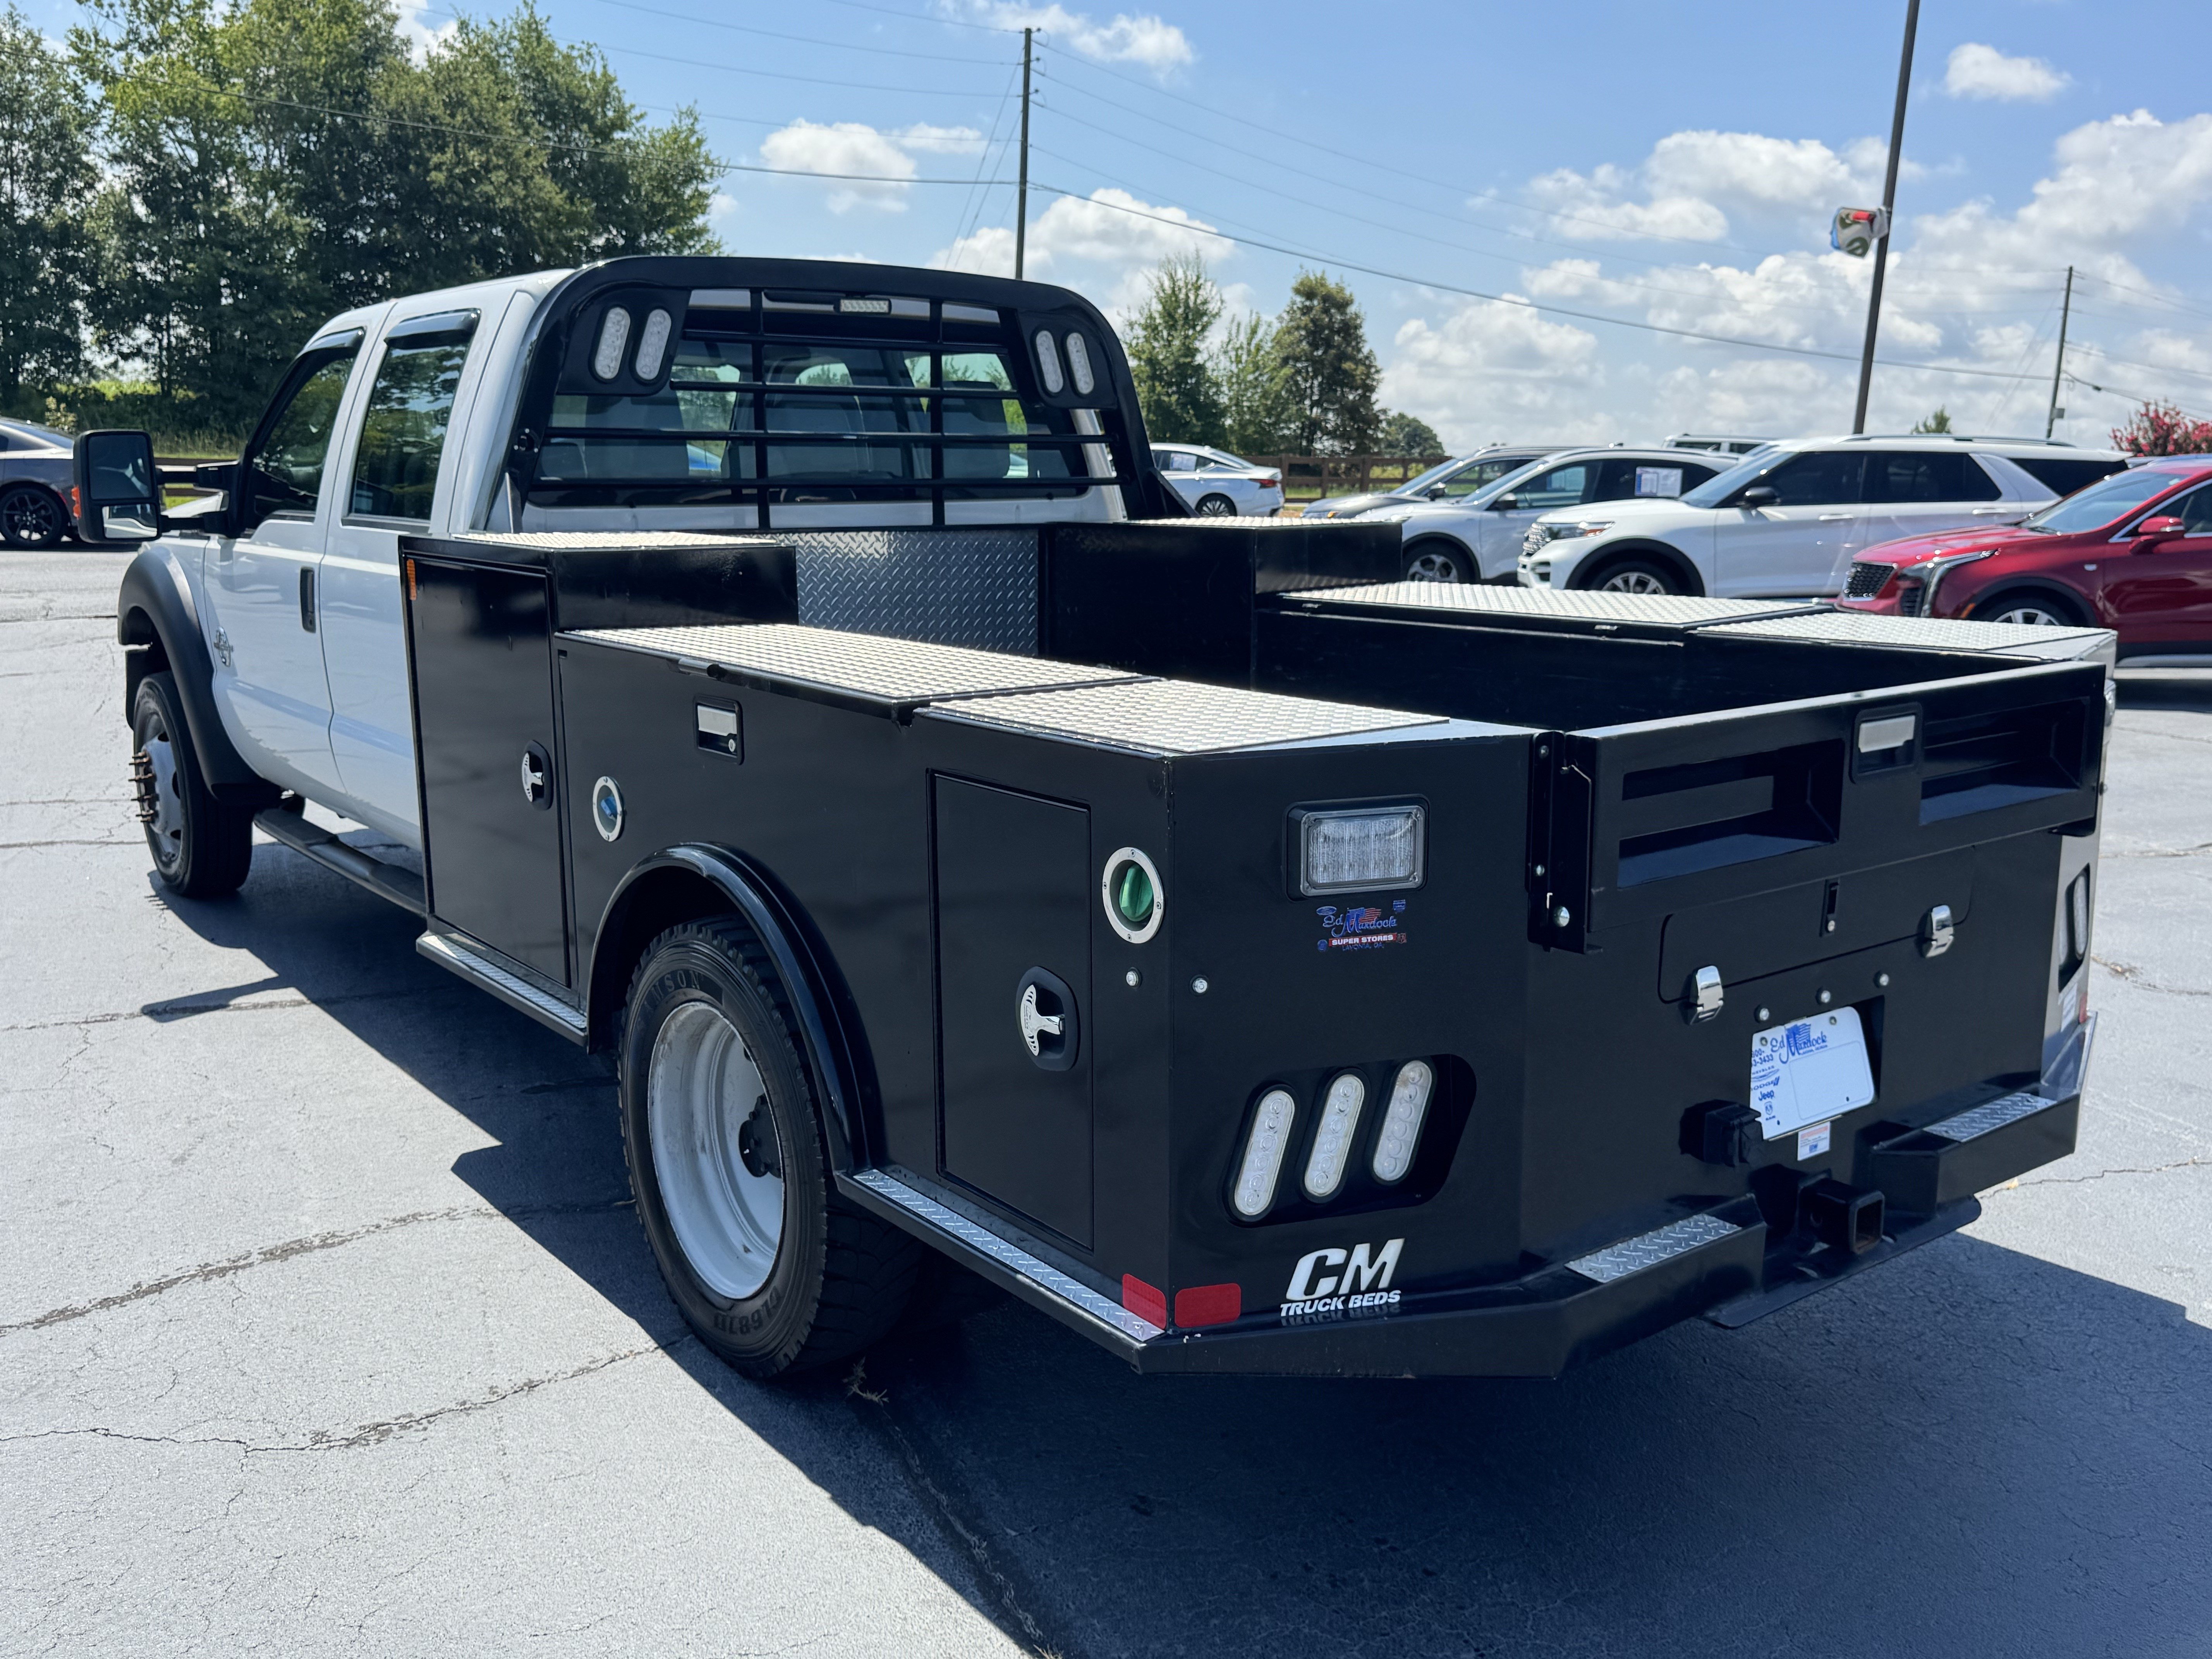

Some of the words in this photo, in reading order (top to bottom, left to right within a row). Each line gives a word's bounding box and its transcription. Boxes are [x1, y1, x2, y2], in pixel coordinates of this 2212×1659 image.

[1323, 914, 1343, 927] Ed
[1332, 938, 1359, 946] SUPER
[1361, 934, 1394, 943] STORES
[1770, 1035, 1785, 1053] Ed
[1779, 1030, 1827, 1064] Murdock
[1752, 1053, 1774, 1066] 3-3433
[1758, 1090, 1774, 1101] Jeep
[1286, 1238, 1405, 1301] CM
[1280, 1296, 1346, 1317] TRUCK
[1348, 1290, 1401, 1309] BEDS
